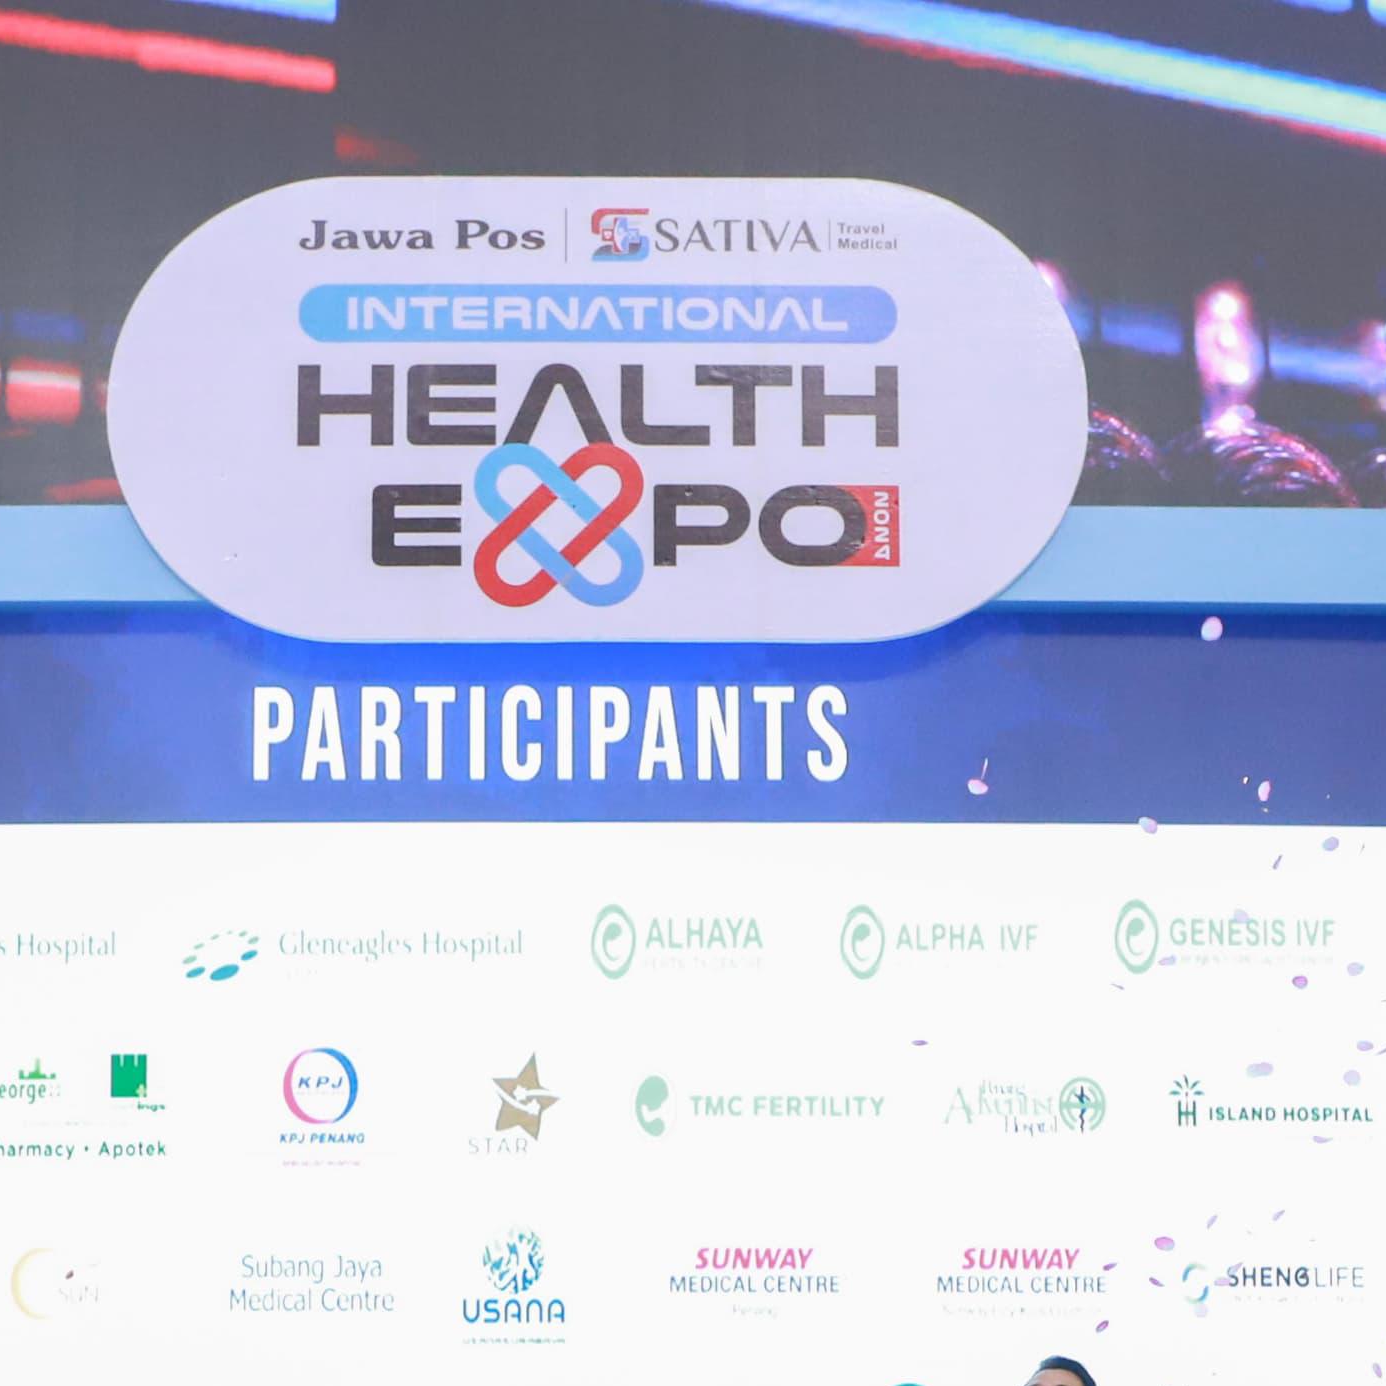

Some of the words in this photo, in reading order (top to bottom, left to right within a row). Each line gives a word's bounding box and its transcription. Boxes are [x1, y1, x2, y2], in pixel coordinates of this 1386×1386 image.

[299, 220, 433, 250] Jawa
[455, 220, 545, 250] Pos
[655, 218, 821, 253] SATIVA
[838, 222, 884, 235] Travel
[838, 237, 898, 250] Medical
[349, 296, 847, 331] INTERNATIONAL
[297, 363, 898, 447] HEALTH
[372, 441, 866, 607] EXPO
[252, 684, 849, 783] PARTICIPANTS
[646, 918, 763, 948] ALHAYA
[896, 924, 985, 950] ALPHA
[999, 924, 1038, 950] IVF
[1170, 918, 1286, 946] GENESIS
[1296, 919, 1336, 946] IVF
[16, 931, 118, 964] Hospital
[279, 931, 412, 962] Gleneagles
[422, 930, 523, 961] Hospital
[298, 1076, 344, 1090] KPJ
[690, 1096, 742, 1116] TMC
[753, 1096, 885, 1116] FERTILITY
[1209, 1107, 1276, 1121] ISLAND
[1283, 1107, 1373, 1122] HOSPITAL
[98, 1141, 165, 1159] Apotek
[280, 1133, 305, 1144] KPJ
[310, 1133, 365, 1144] PENANG
[468, 1137, 529, 1154] STAR
[241, 1254, 324, 1283] Subang
[333, 1255, 383, 1282] Jaya
[695, 1247, 813, 1269] SUNWAY
[962, 1247, 1079, 1269] SUNWAY
[670, 1275, 756, 1293] MEDICAL
[763, 1275, 840, 1293] CENTRE
[937, 1275, 1023, 1293] MEDICAL
[1030, 1275, 1106, 1293] CENTRE
[229, 1288, 312, 1311] Medical
[321, 1288, 395, 1311] Centre
[463, 1298, 566, 1323] USANA
